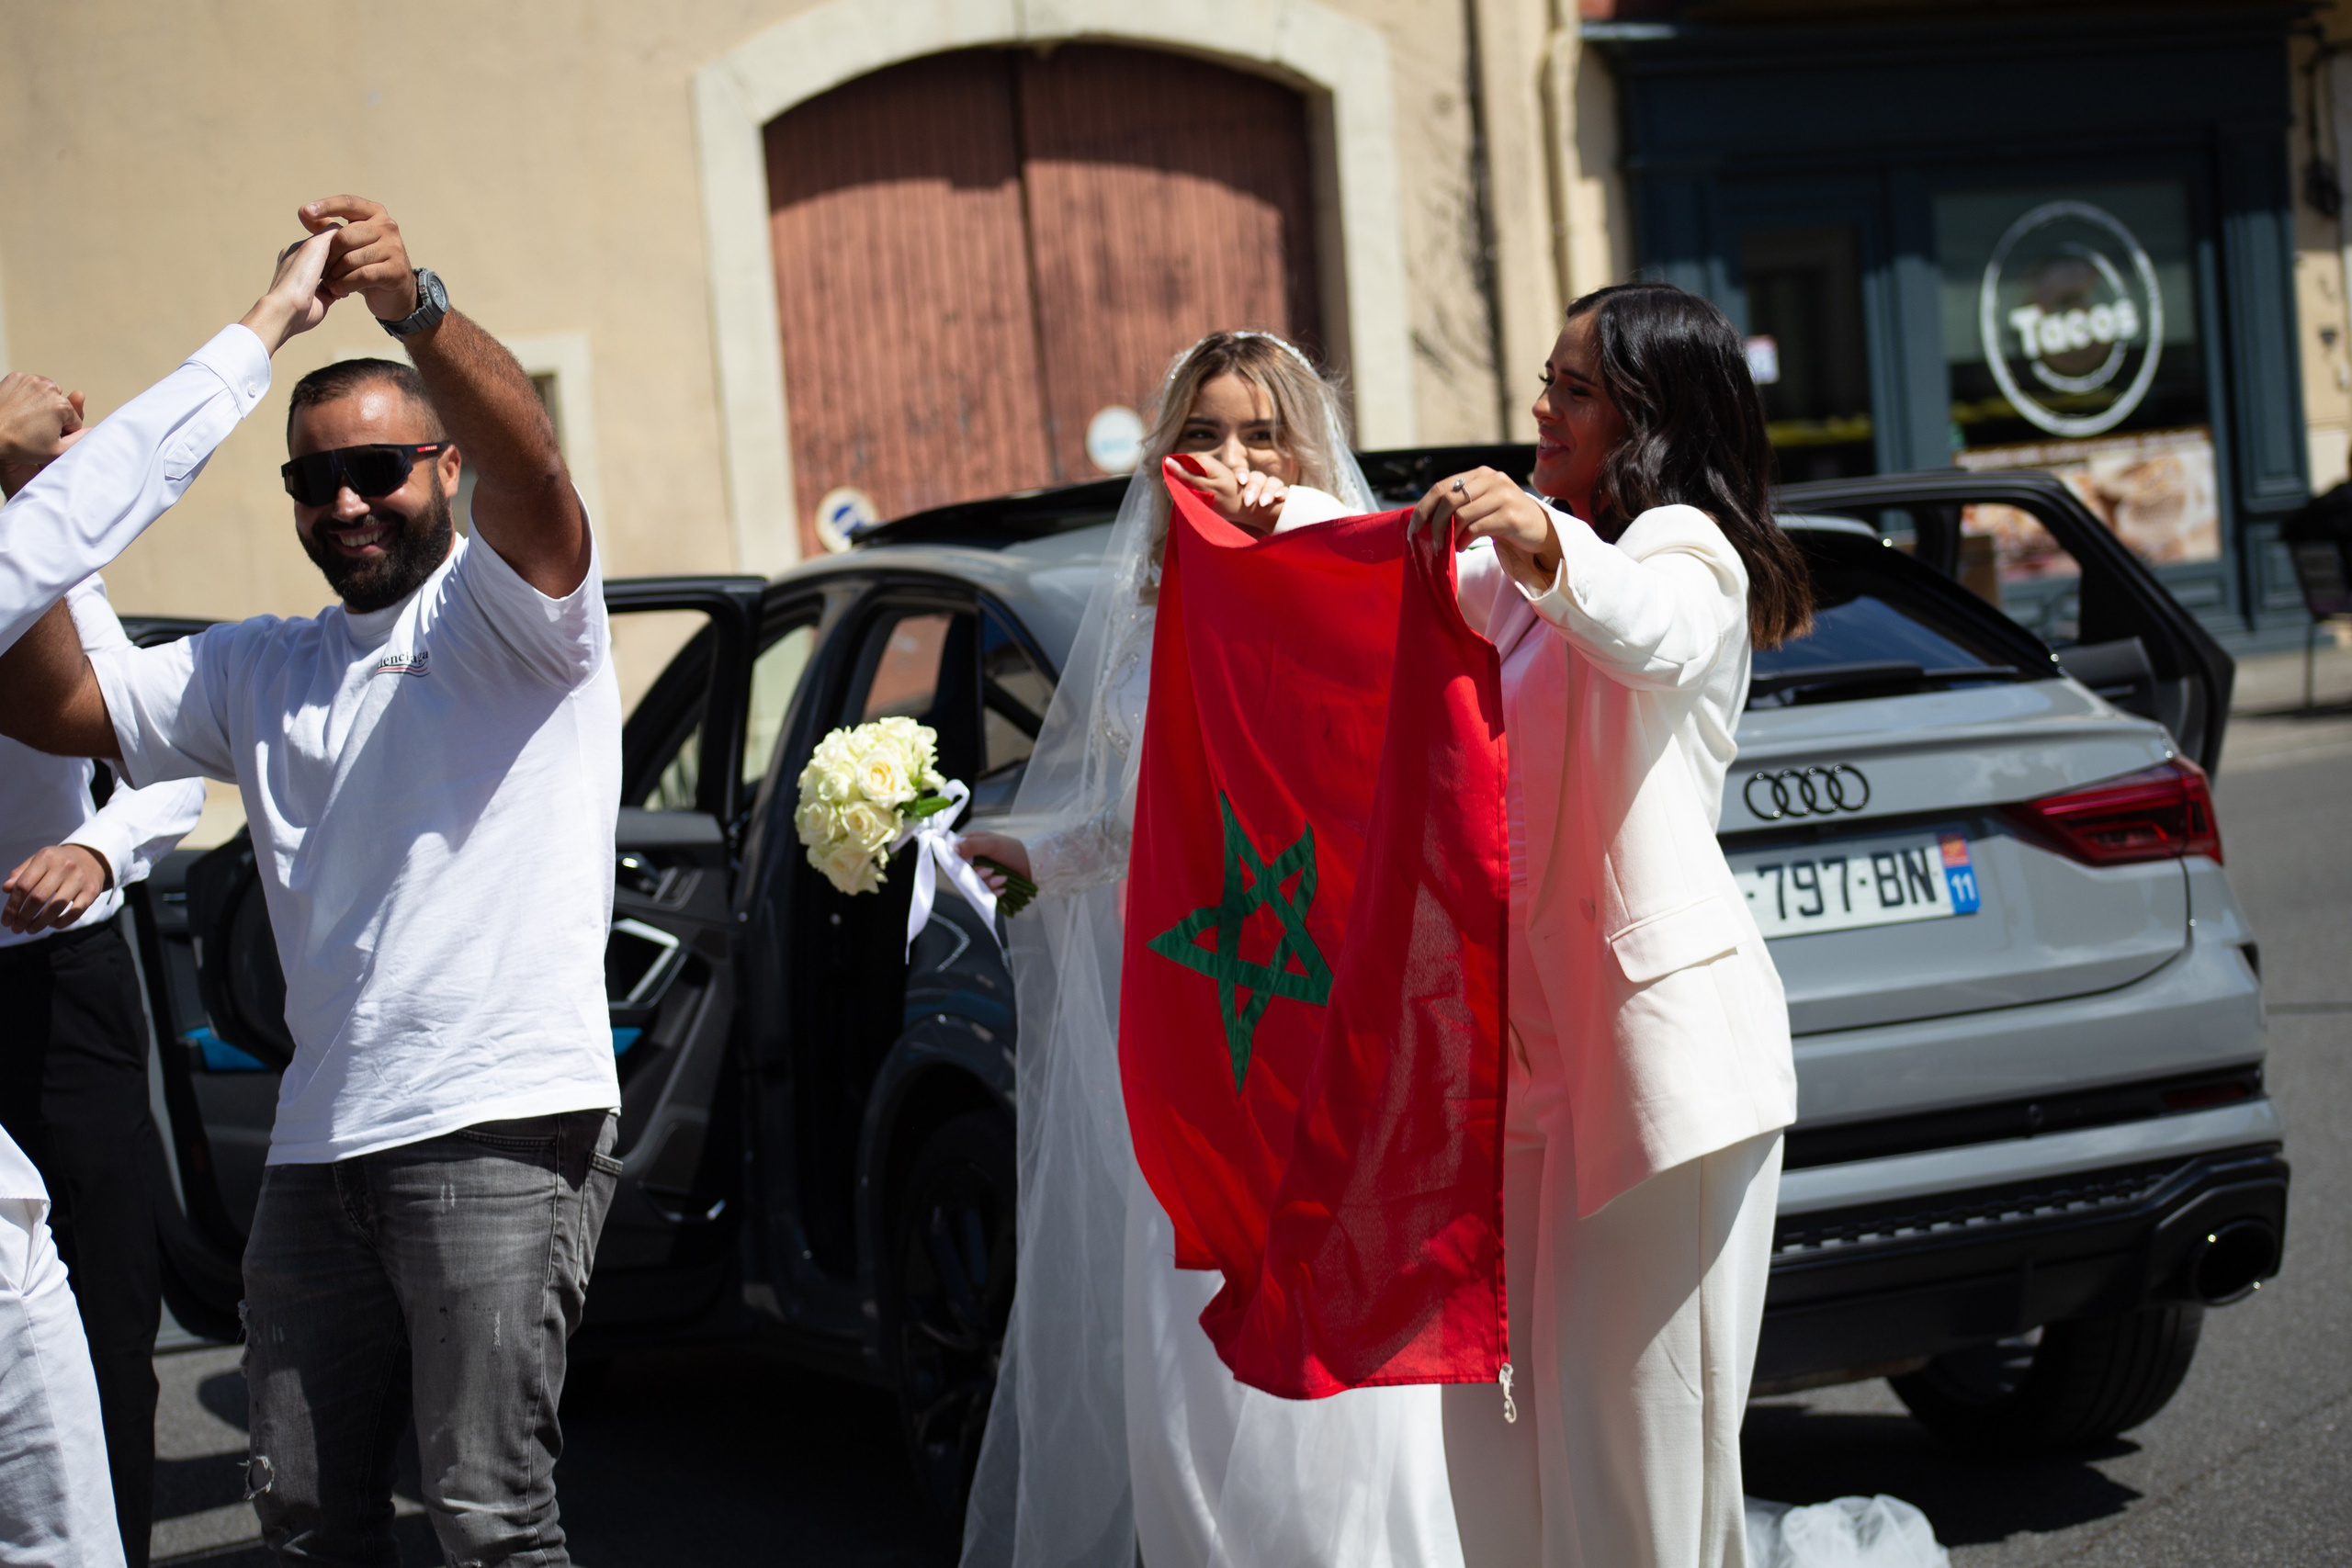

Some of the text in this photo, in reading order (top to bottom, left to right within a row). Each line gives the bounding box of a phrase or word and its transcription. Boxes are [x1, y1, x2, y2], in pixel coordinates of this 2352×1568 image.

[2008, 298, 2140, 359] Tacos
[378, 651, 429, 668] lenciaga
[1747, 847, 1937, 921] -797-BN
[1950, 873, 1976, 903] 11
